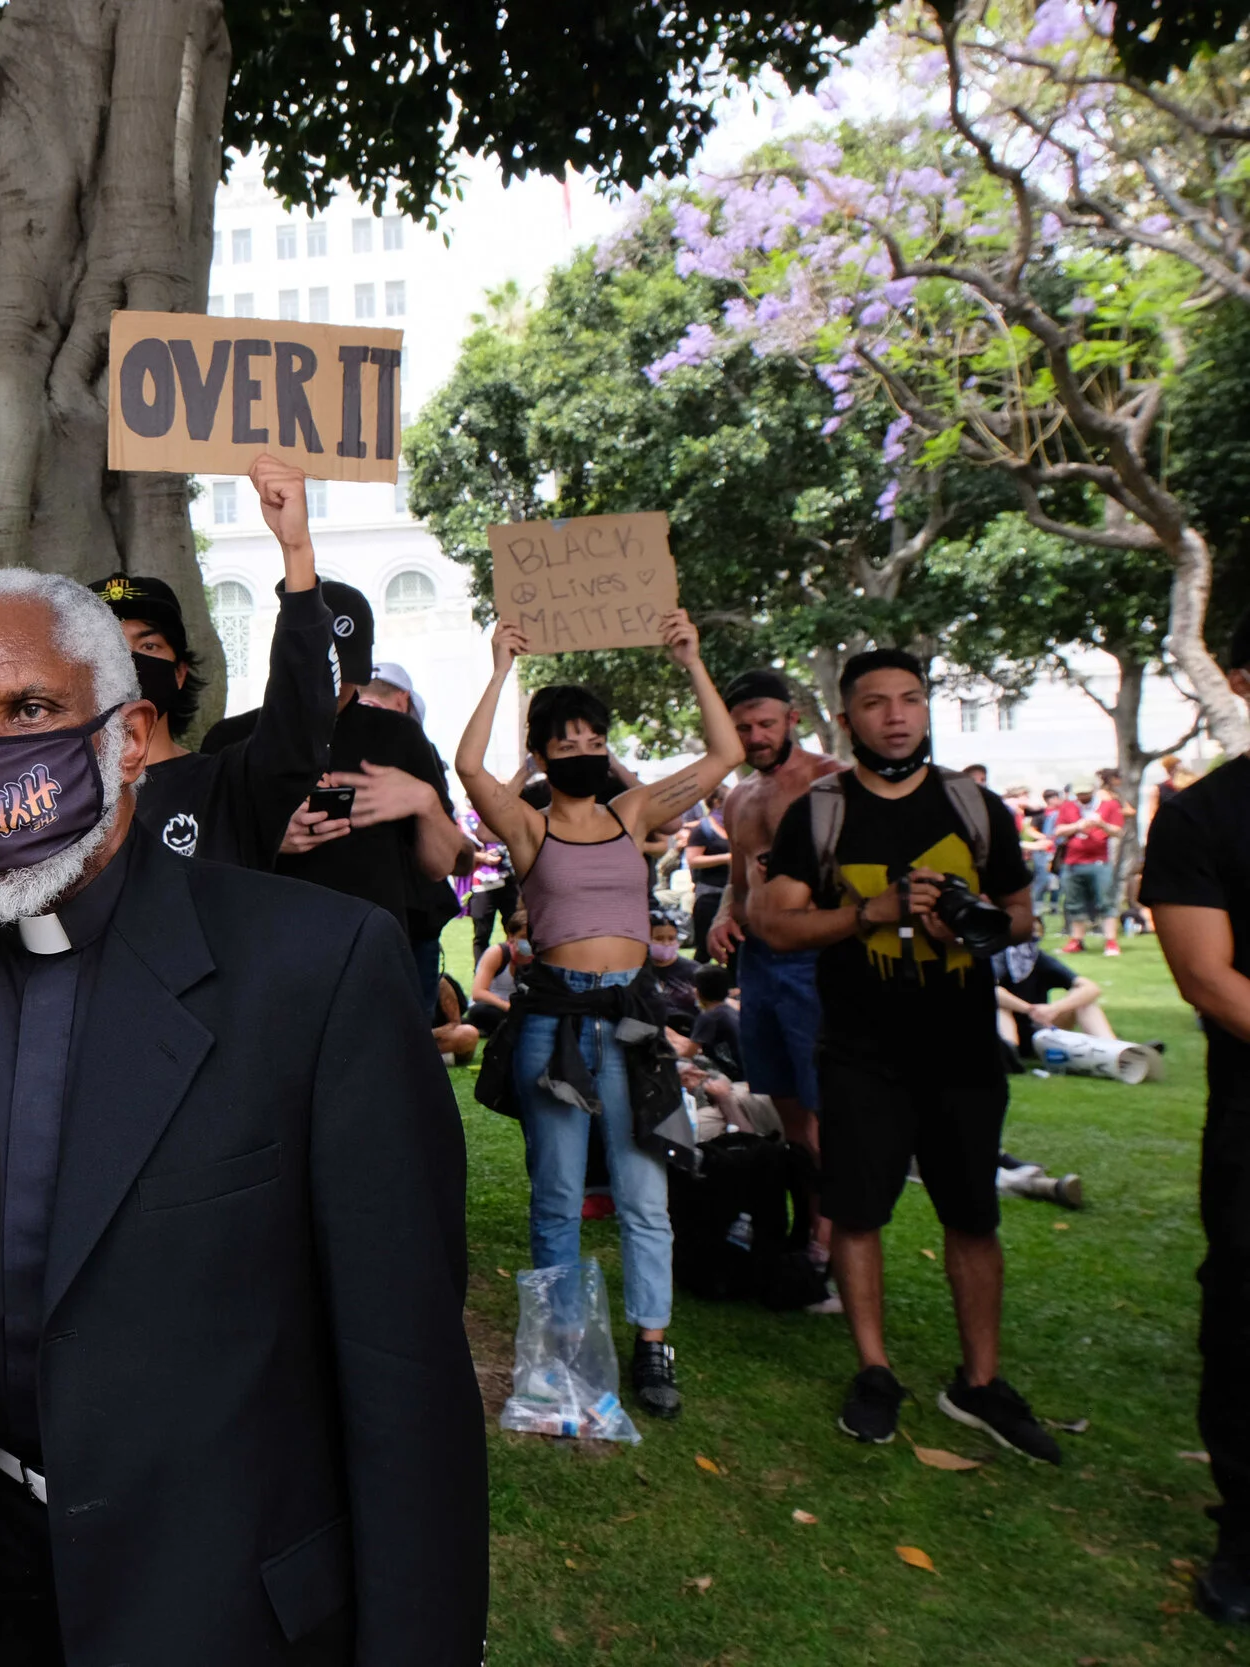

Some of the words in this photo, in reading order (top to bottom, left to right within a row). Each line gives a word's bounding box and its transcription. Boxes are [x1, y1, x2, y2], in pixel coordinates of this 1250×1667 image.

[120, 337, 324, 455] OVER
[336, 345, 402, 460] IT
[507, 525, 644, 576] BLACK
[105, 578, 129, 591] ANTI
[32, 813, 58, 832] THE
